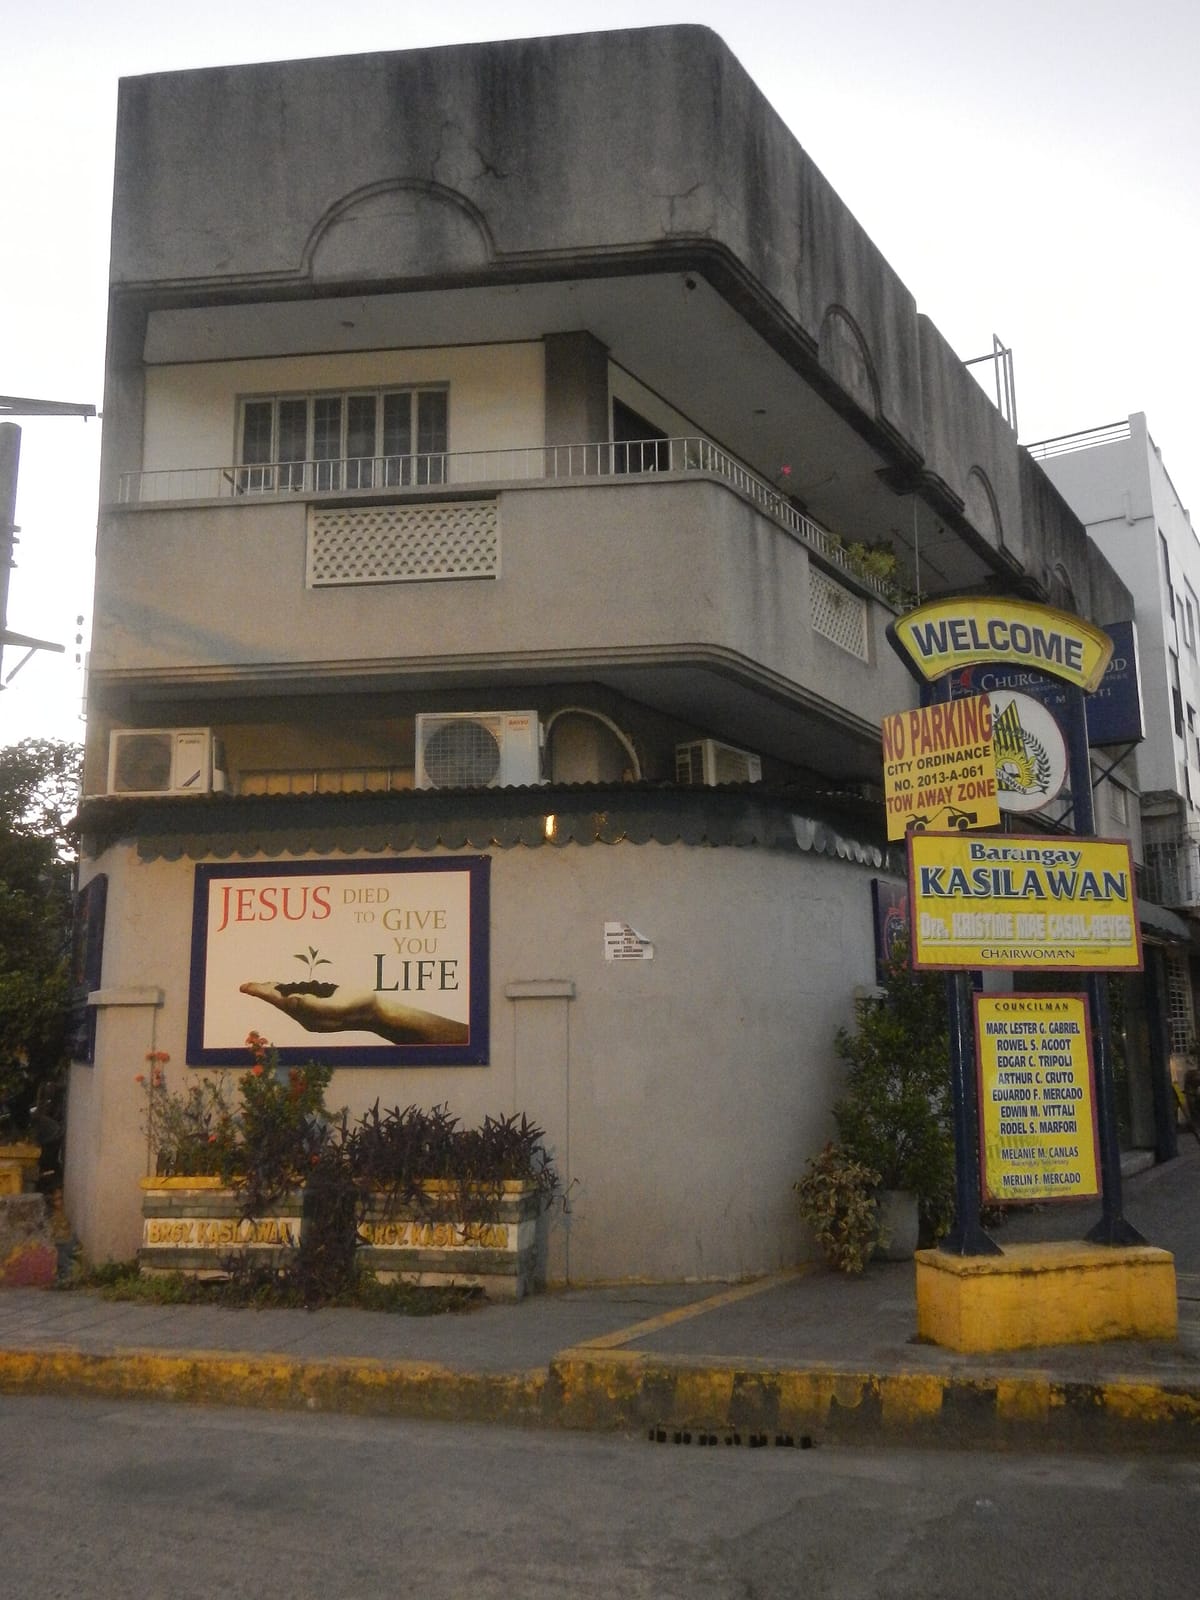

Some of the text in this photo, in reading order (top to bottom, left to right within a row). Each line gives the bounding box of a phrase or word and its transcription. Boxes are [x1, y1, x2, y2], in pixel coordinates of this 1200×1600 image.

[911, 618, 1083, 672] WELCOME
[882, 694, 993, 763] NO PARKING
[887, 745, 991, 776] CITY ORDINANCE
[894, 764, 984, 792] NO. 2013-A-061
[887, 778, 996, 814] TOW AWAY ZONE
[970, 843, 1081, 867] Barangay
[920, 867, 1127, 900] KASILAWAN
[217, 885, 390, 932] JESUS DIED
[354, 908, 447, 931] TO GIVE
[393, 937, 438, 954] YOU
[981, 949, 1075, 960] CHAIRWOMAN
[373, 953, 459, 992] LIFE
[994, 1002, 1069, 1012] COUNCILMAN
[986, 1022, 1008, 1035] MARC
[1010, 1022, 1037, 1035] LESTER
[1049, 1022, 1080, 1034] GABRIEL
[996, 1039, 1028, 1051] ROWEL
[1030, 1039, 1038, 1051] S.
[997, 1055, 1073, 1067] EDGAR C. TRIPOLI
[998, 1071, 1074, 1084] ARTHUR C. CRUTO
[992, 1087, 1083, 1101] EDUARDO F. MERCADO
[1000, 1104, 1075, 1118] EDWIN M. VITTALI
[1000, 1121, 1077, 1134] RODEL S. MARFORI
[1001, 1148, 1036, 1160] MELANIE
[1049, 1146, 1079, 1157] CANLAS
[1003, 1173, 1033, 1186] MERLIN
[1043, 1172, 1081, 1184] MERCADO
